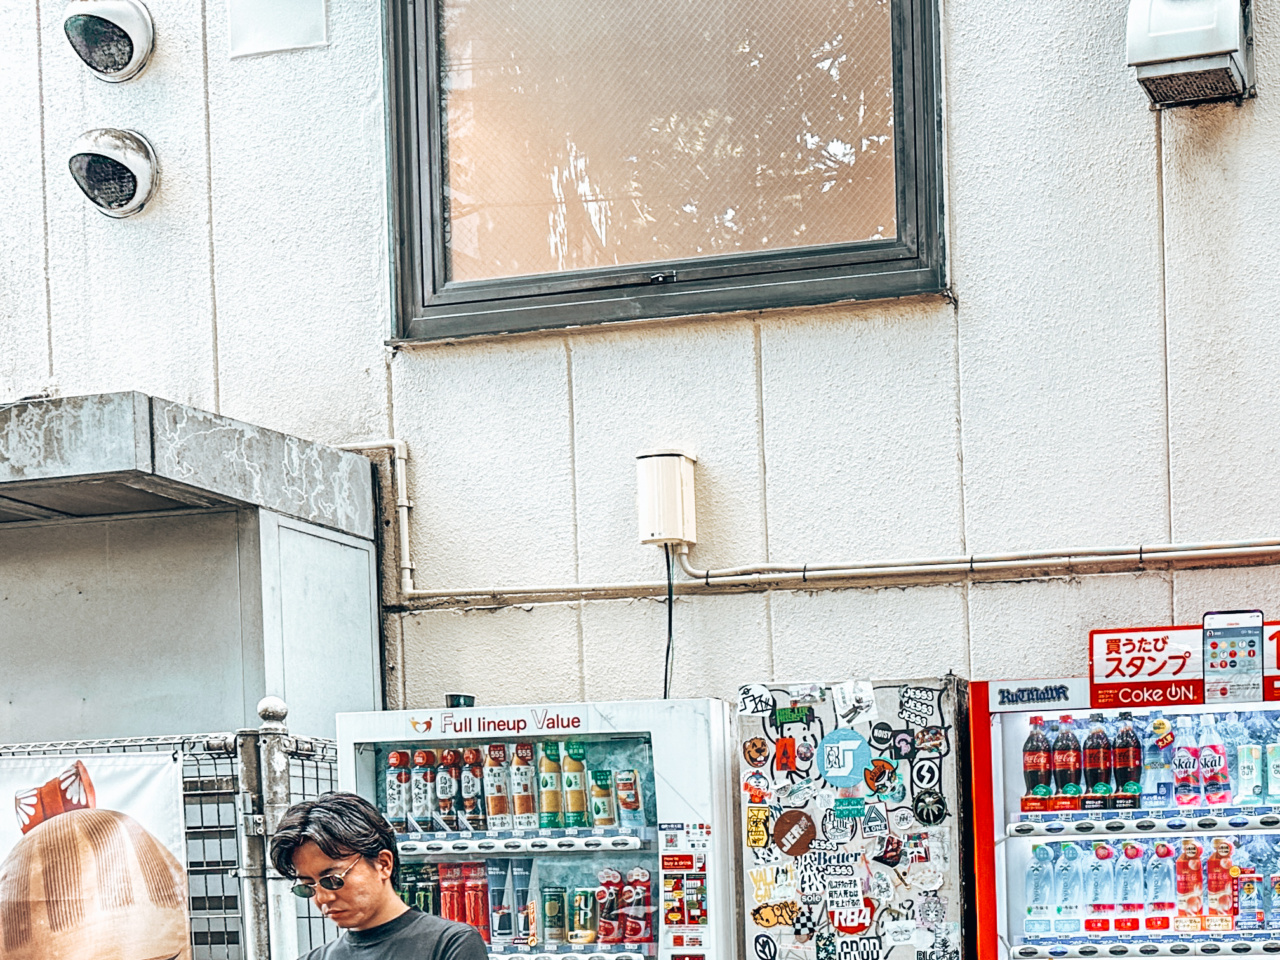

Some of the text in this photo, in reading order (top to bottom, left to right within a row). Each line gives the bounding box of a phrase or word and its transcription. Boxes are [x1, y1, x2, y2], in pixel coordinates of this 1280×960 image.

[1105, 636, 1169, 655] 買うたび
[1105, 651, 1192, 679] スタンプ
[903, 687, 934, 701] JESS3
[1118, 688, 1163, 704] Coke
[904, 701, 934, 717] JESS3
[441, 709, 581, 735] Full lineup Value
[898, 711, 928, 727] JESS3
[809, 839, 838, 851] JESS3
[817, 850, 861, 865] Better
[825, 865, 854, 875] JESS3
